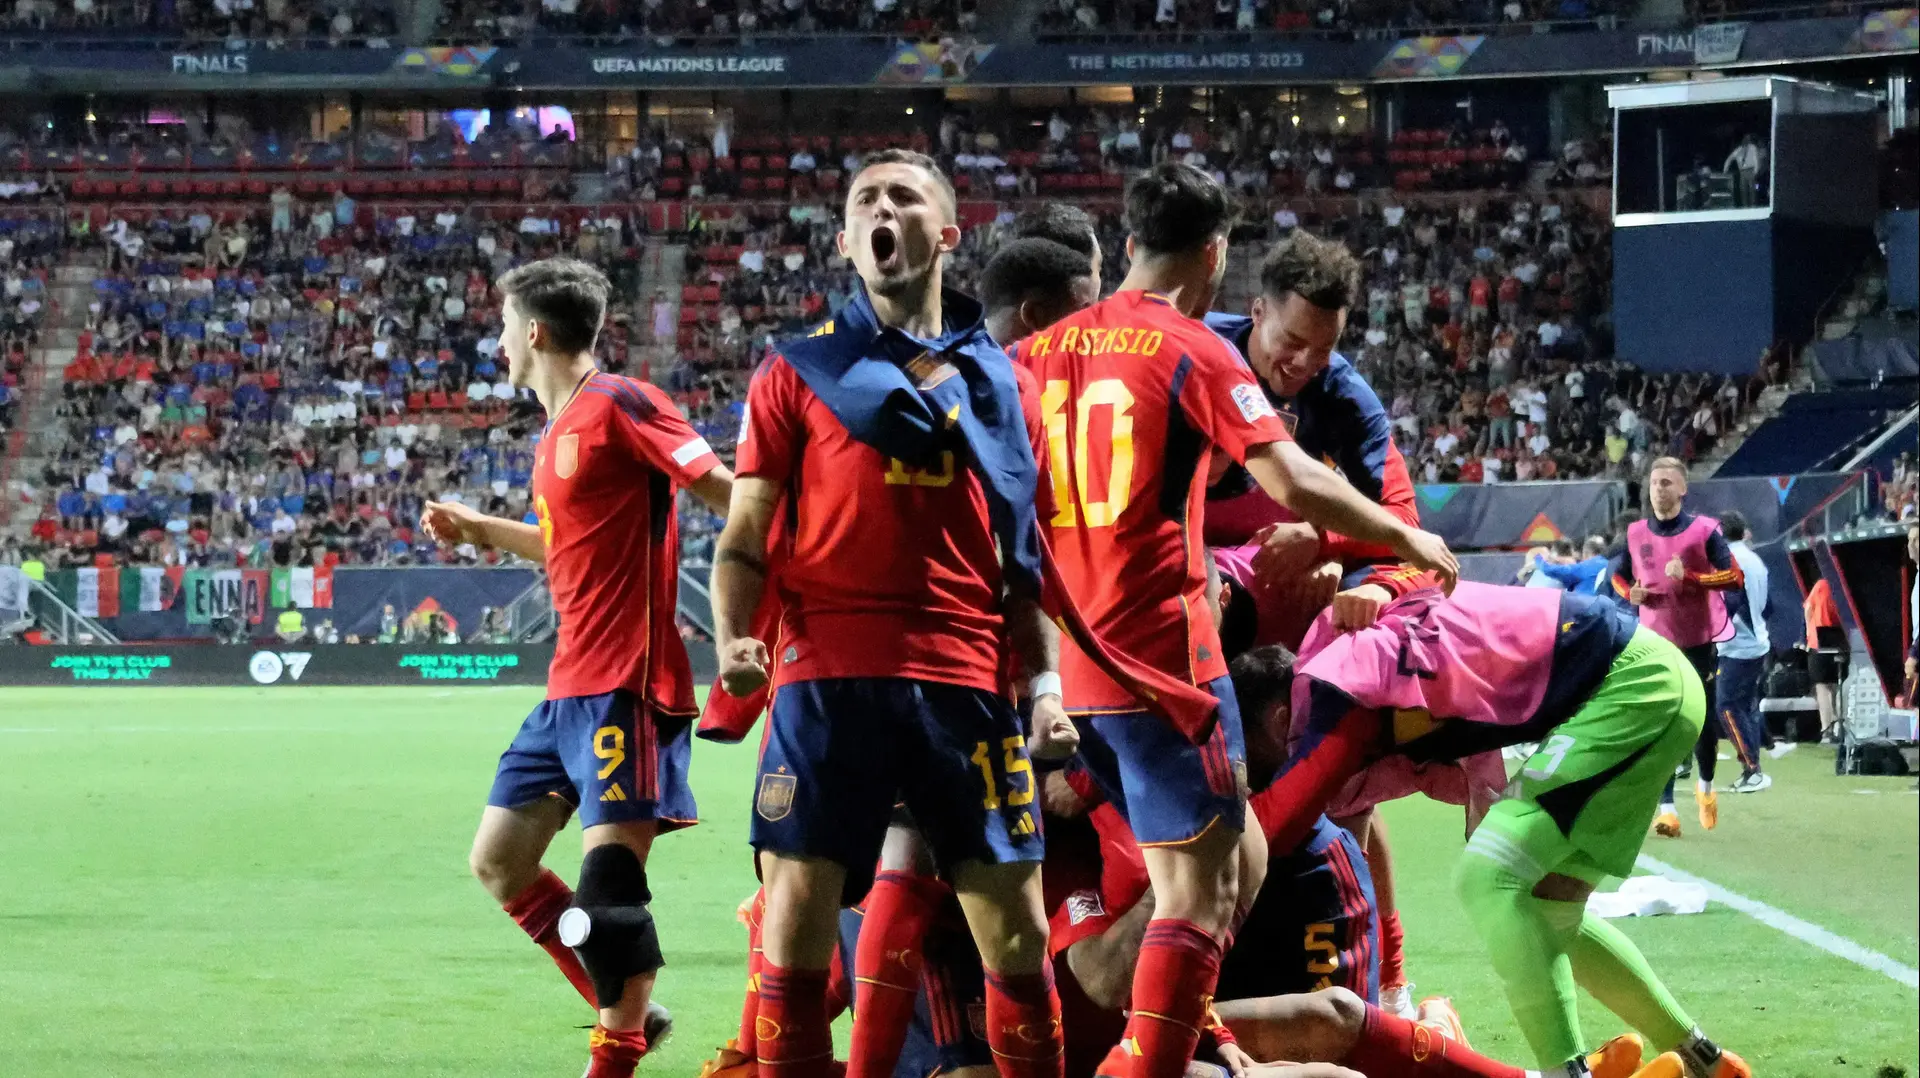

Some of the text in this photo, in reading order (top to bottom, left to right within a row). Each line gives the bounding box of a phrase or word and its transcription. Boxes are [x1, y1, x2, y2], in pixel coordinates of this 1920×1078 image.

[1637, 34, 1696, 55] FINAL
[172, 55, 248, 73] FINALS
[592, 57, 785, 73] UEFA NATIONS LEAGUE
[1068, 52, 1304, 69] THE NETHERLANDS 2023
[1060, 326, 1163, 356] ASENSIO
[1041, 379, 1135, 528] 10
[195, 579, 259, 617] ENNA
[50, 655, 171, 668] JOIN THE CLUB
[399, 655, 518, 667] JOIN THE CLUB
[73, 667, 152, 679] THIS JULY
[421, 667, 500, 679] THIS JULY
[593, 725, 625, 781] 9
[970, 734, 1035, 811] 15
[1304, 923, 1339, 974] 5
